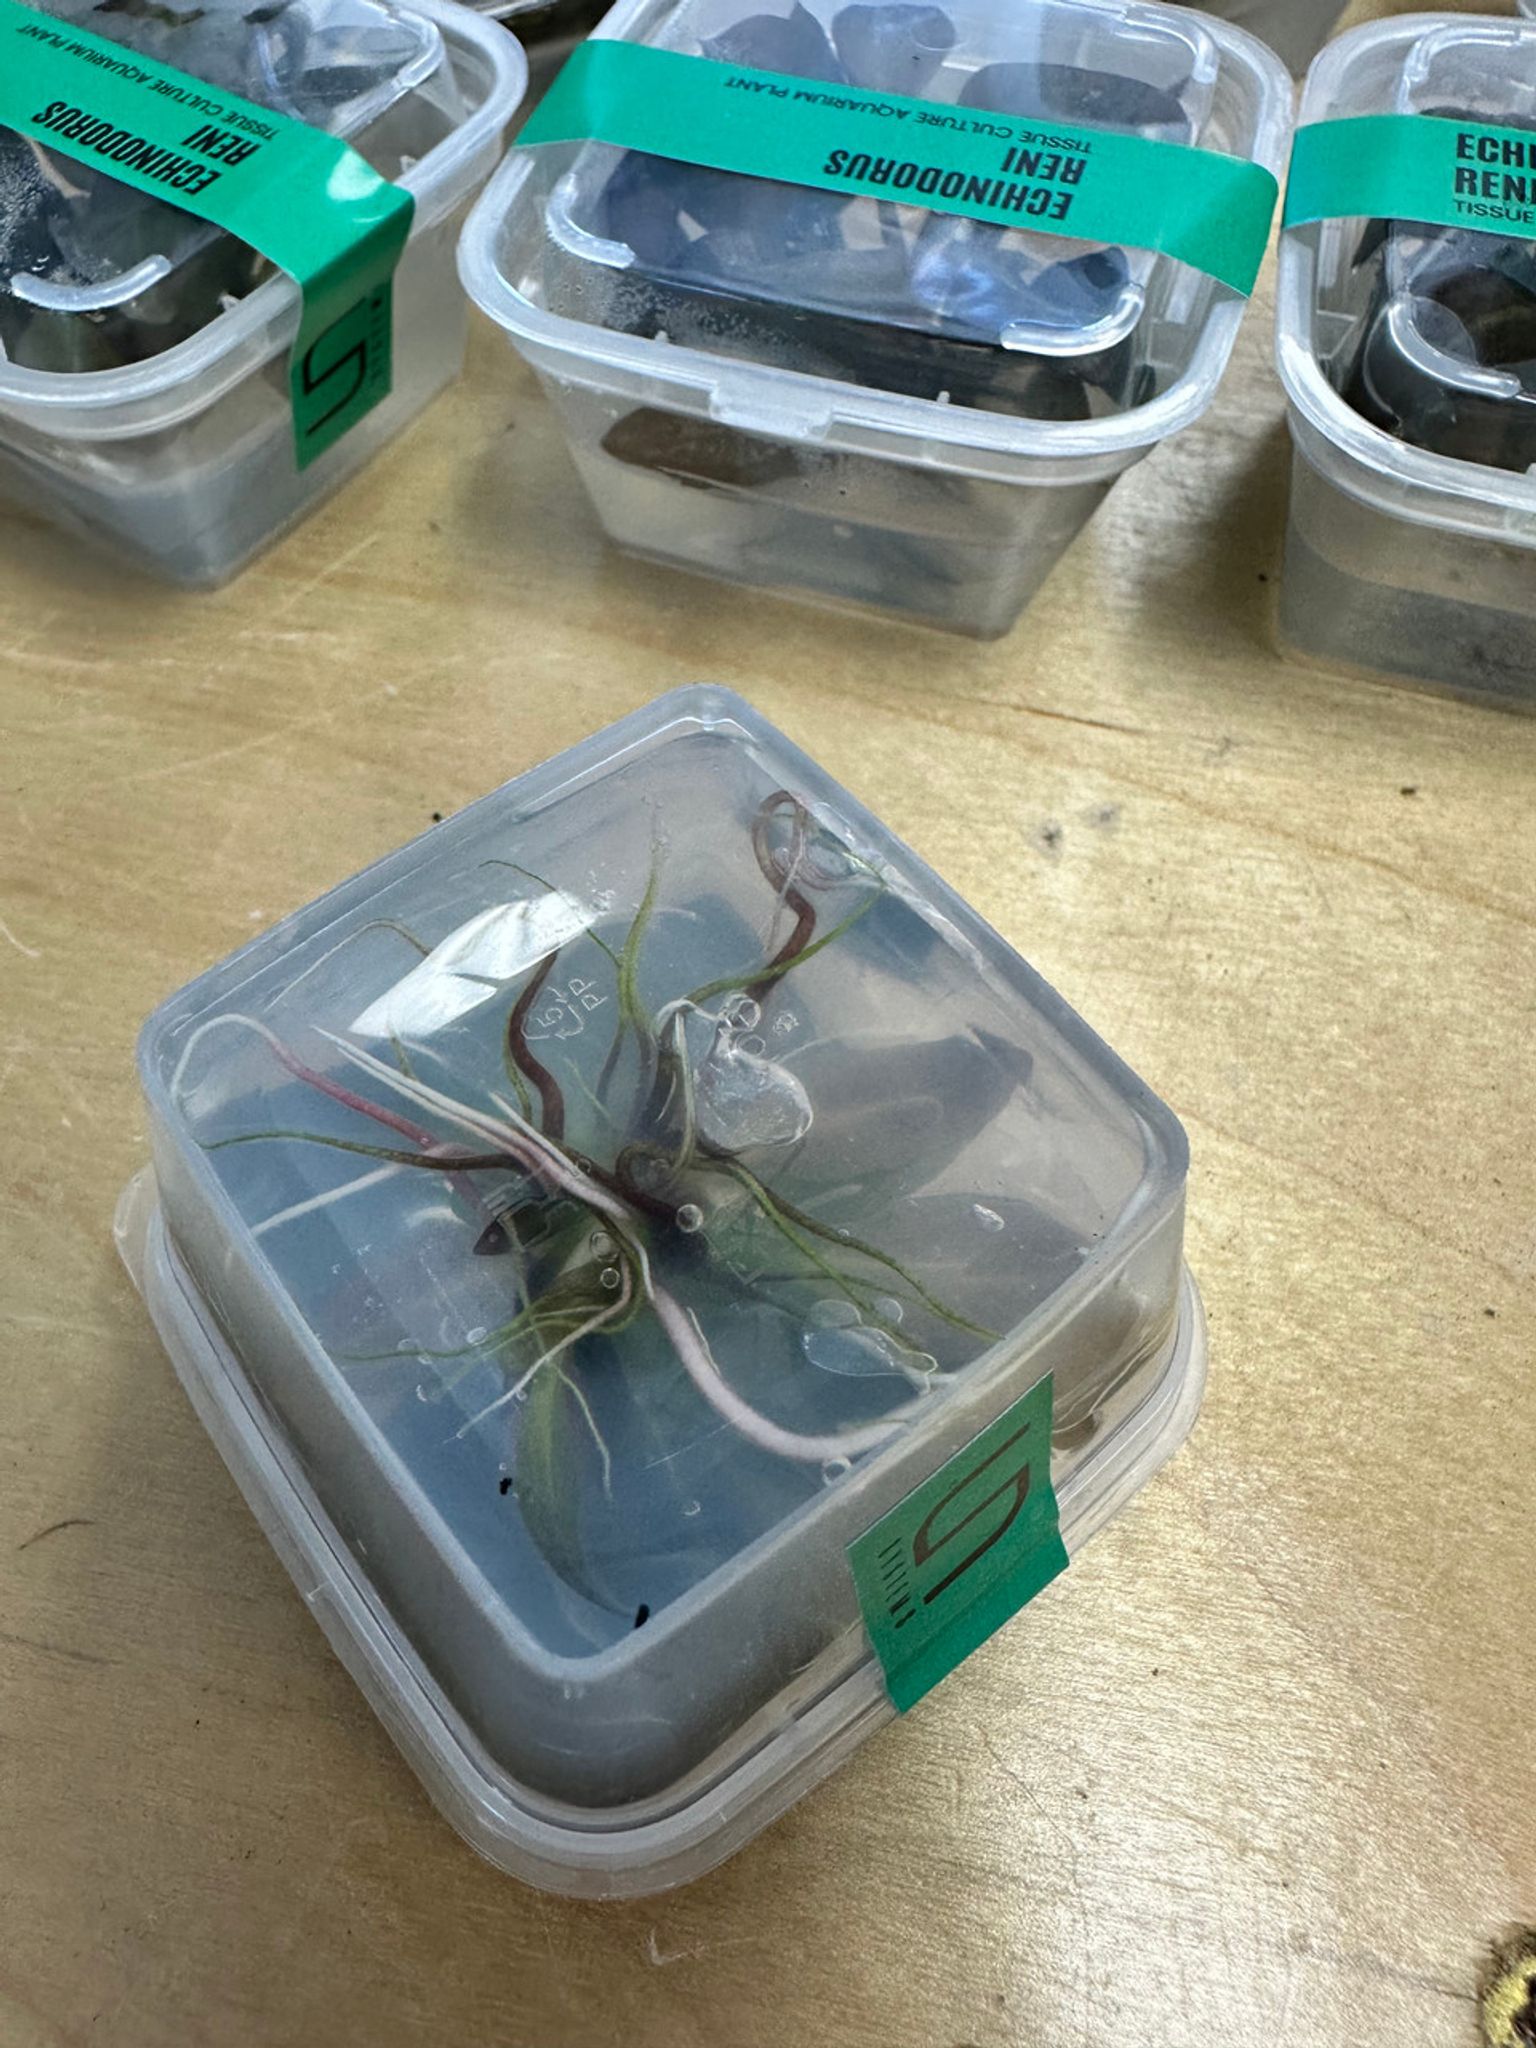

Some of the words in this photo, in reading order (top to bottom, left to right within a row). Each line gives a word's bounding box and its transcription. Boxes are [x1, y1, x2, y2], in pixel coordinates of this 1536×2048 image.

[15, 24, 70, 49] PLANT
[64, 42, 154, 83] AQUARIUM
[147, 79, 224, 116] CULTURE
[724, 76, 790, 98] PLANT
[793, 91, 912, 119] AQUARIUM
[221, 111, 280, 140] TISSUE
[914, 111, 1013, 139] CULTURE
[31, 101, 222, 195] ECHINODORUS
[181, 124, 262, 166] RENI
[1018, 131, 1093, 154] TISSUE
[1000, 147, 1087, 185] RENI
[823, 149, 1074, 220] ECHINODORUS
[1453, 199, 1535, 224] TISSUE
